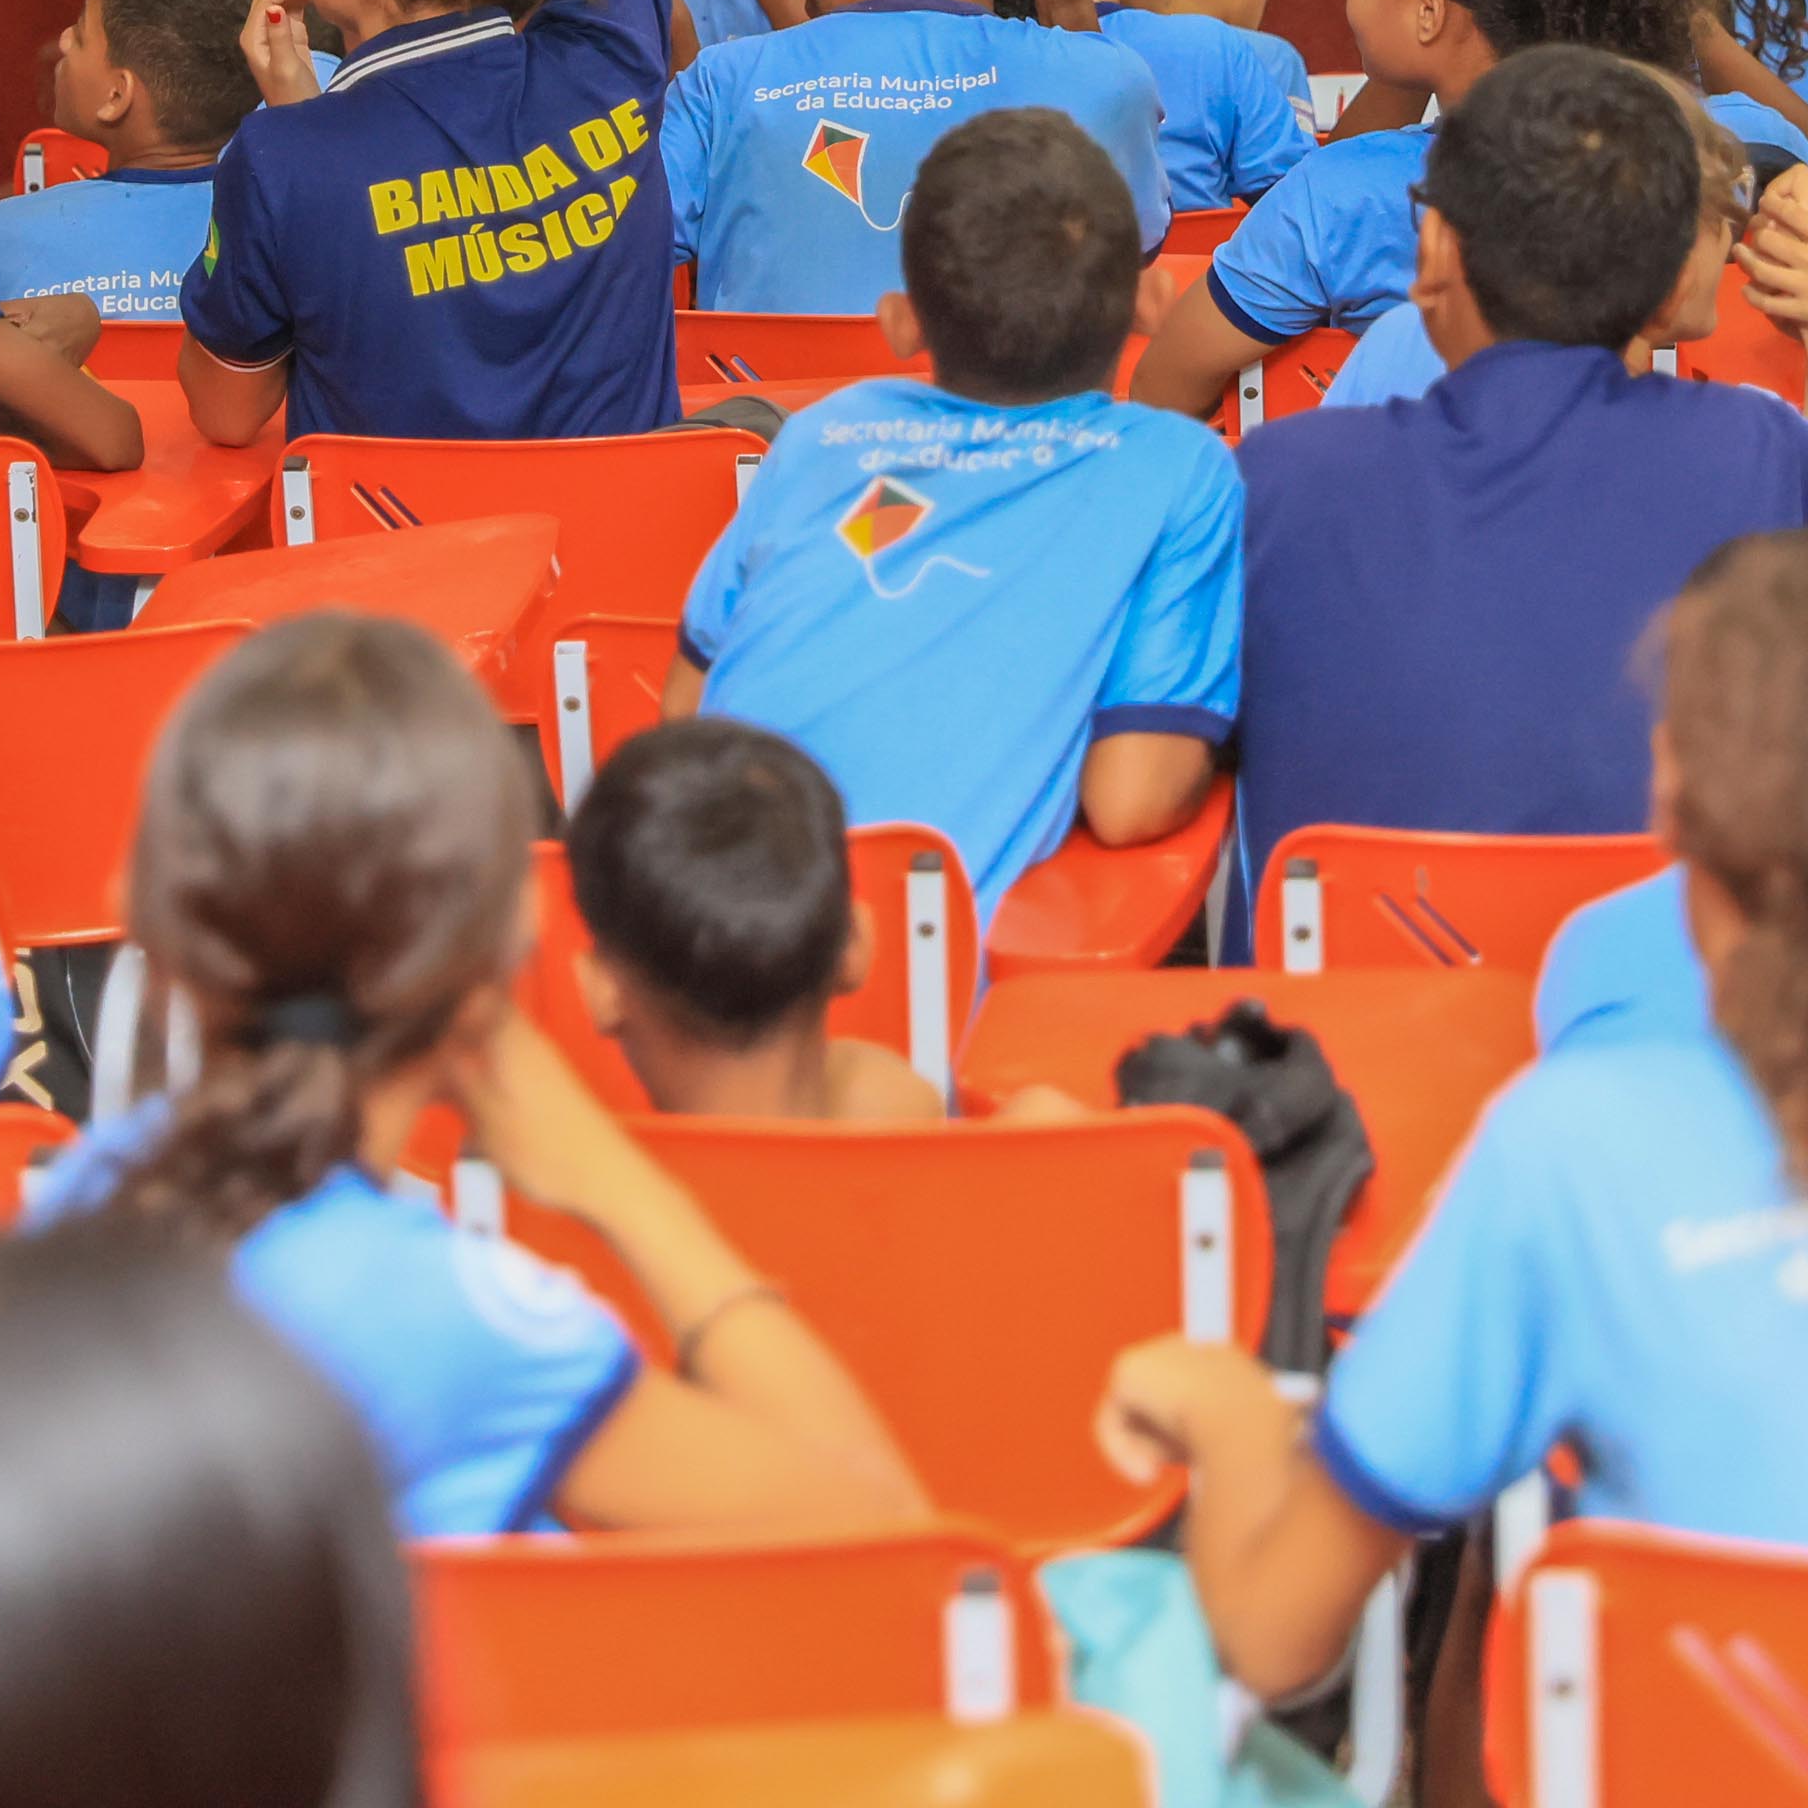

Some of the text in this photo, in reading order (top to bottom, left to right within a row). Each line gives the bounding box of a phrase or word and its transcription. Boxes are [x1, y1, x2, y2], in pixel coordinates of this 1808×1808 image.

[754, 66, 999, 102] Secretaria Municipal
[796, 92, 953, 114] da Educação
[368, 97, 649, 235] BANDA DE
[102, 292, 177, 314] Educa
